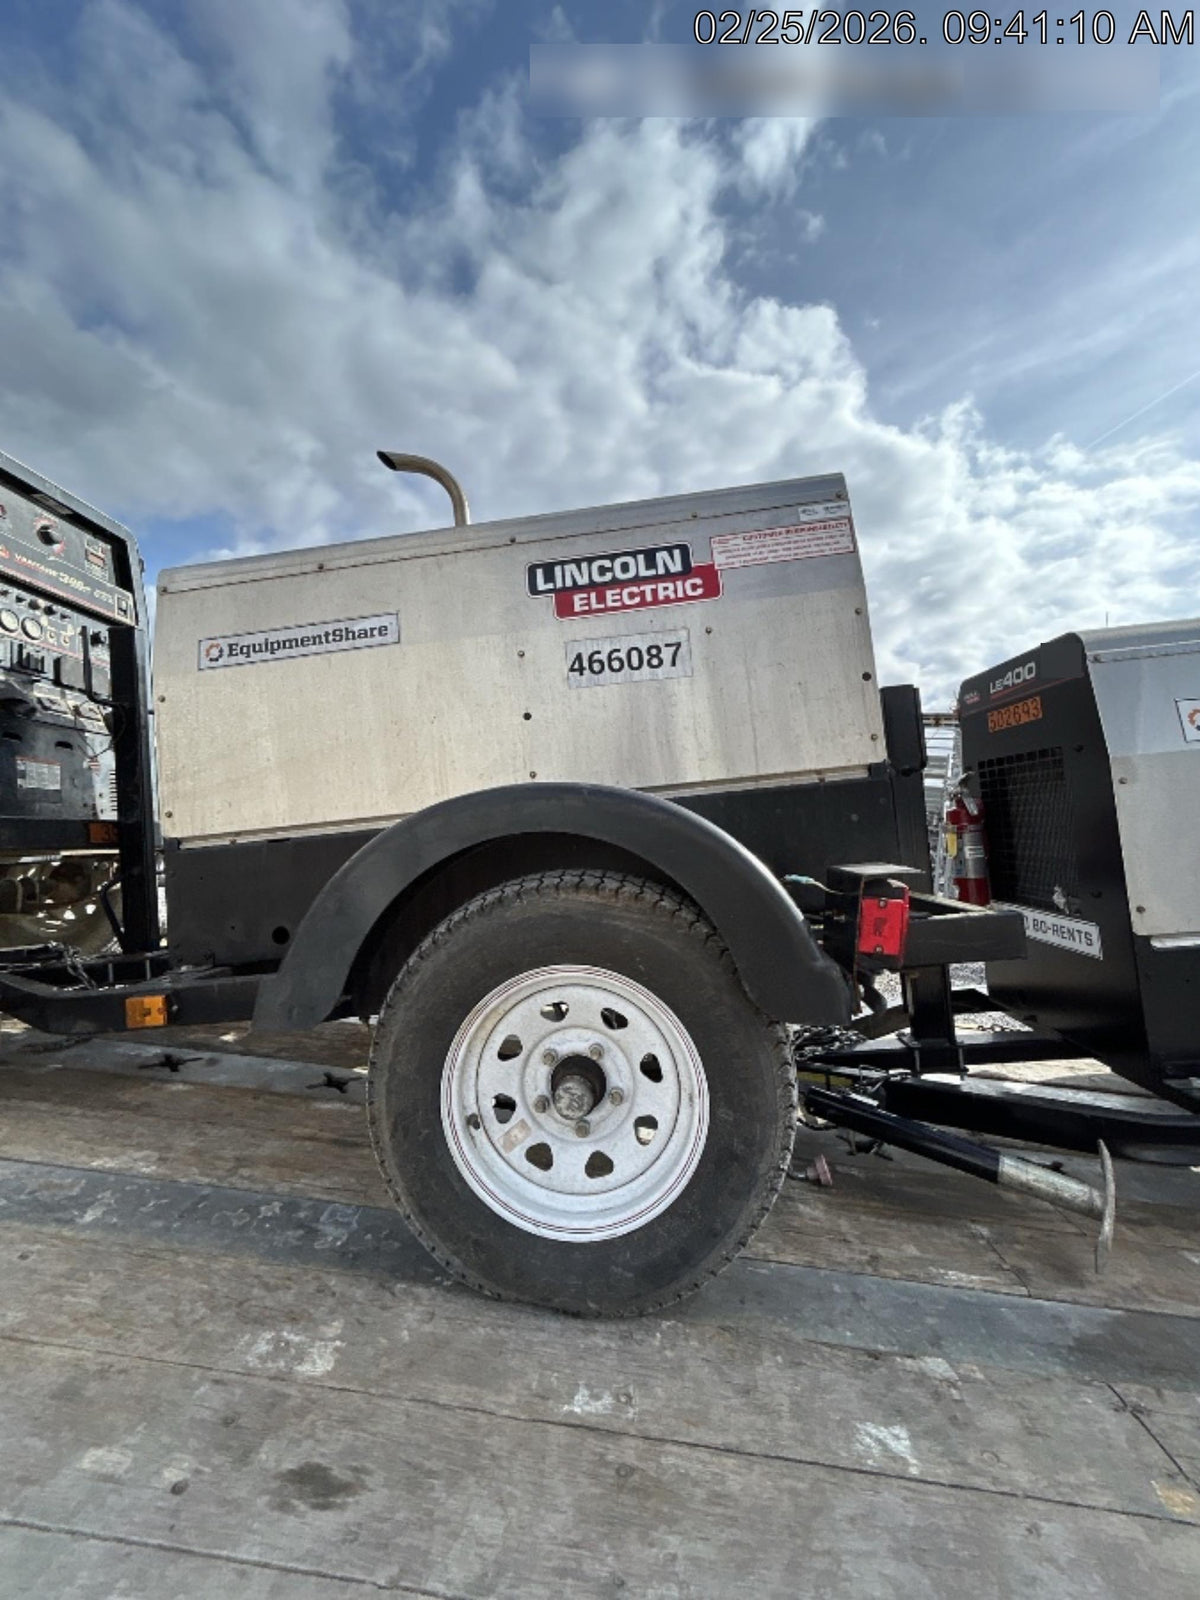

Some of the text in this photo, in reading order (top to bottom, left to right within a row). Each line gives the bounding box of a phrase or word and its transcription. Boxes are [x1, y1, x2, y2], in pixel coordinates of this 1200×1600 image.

[536, 548, 684, 591] LINCOLN
[573, 577, 704, 612] ELECTRIC
[227, 624, 389, 658] EquipmentShare
[568, 641, 682, 676] 466087
[989, 662, 1036, 694] LE400
[989, 697, 1040, 731] 502693
